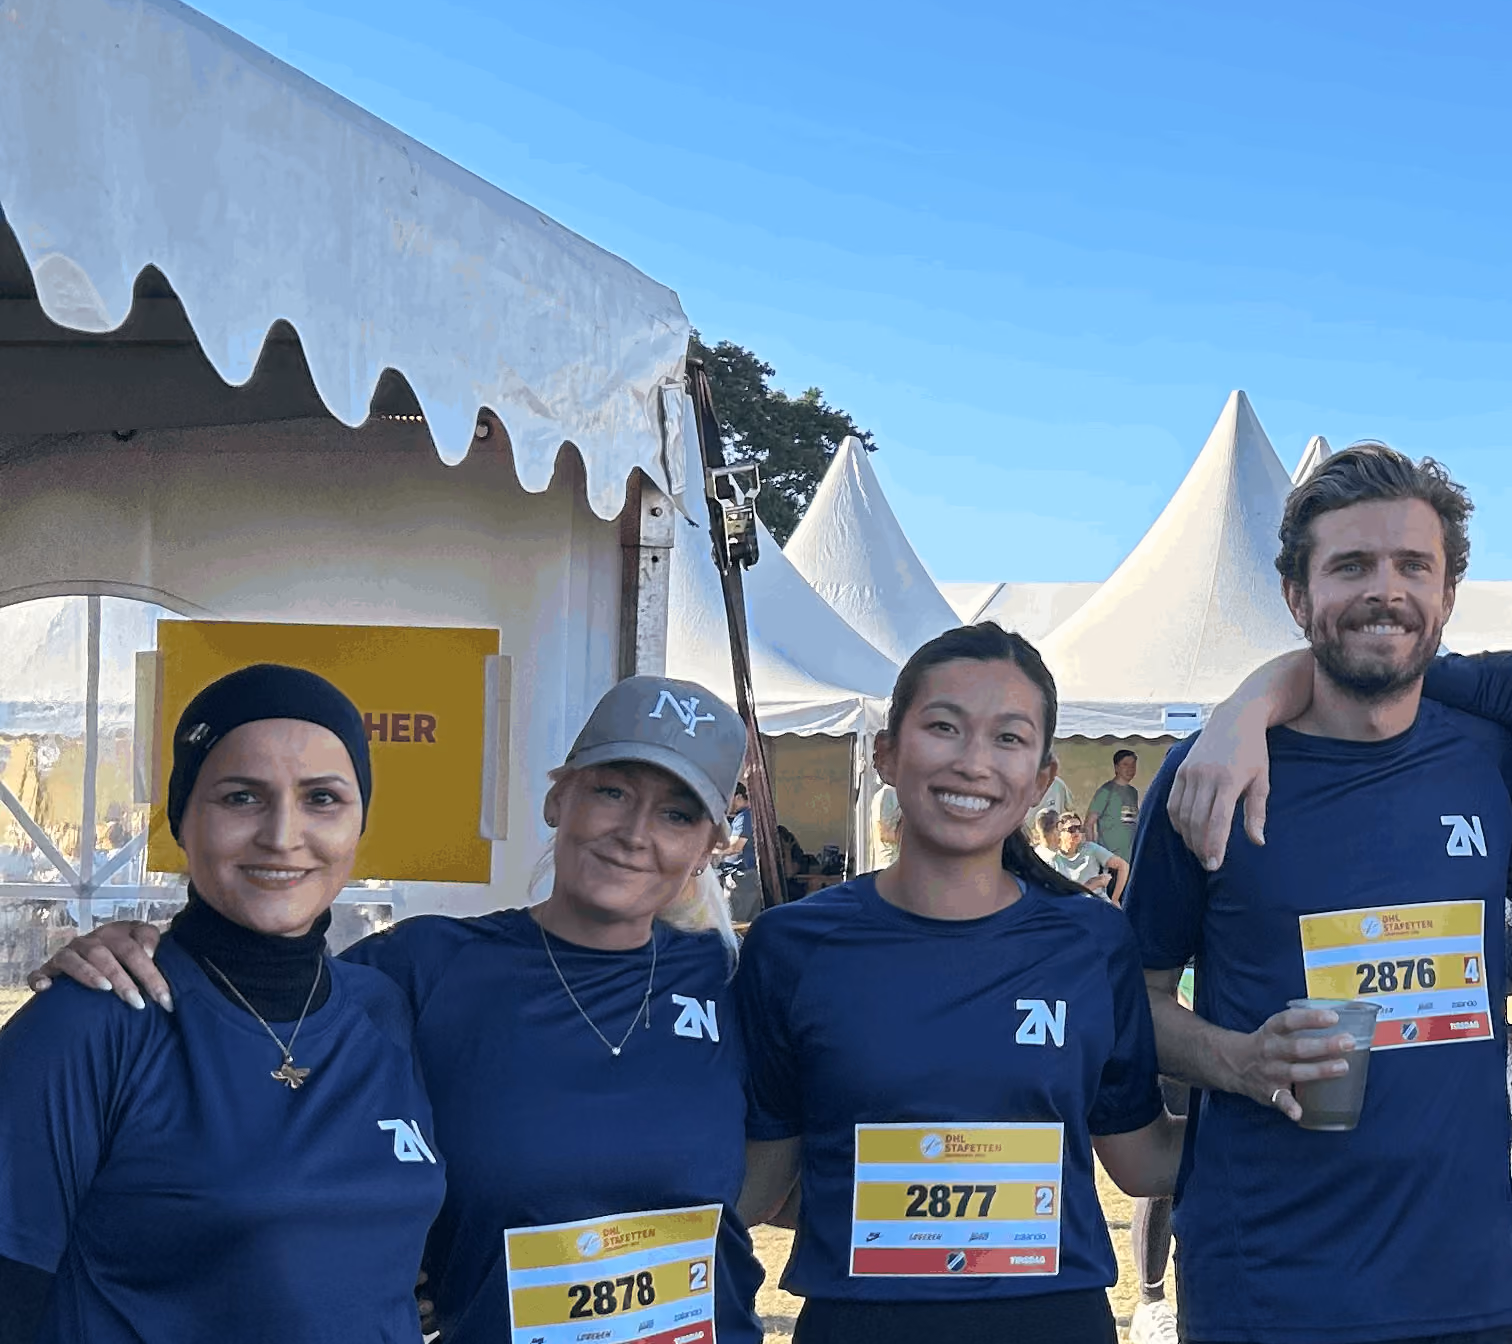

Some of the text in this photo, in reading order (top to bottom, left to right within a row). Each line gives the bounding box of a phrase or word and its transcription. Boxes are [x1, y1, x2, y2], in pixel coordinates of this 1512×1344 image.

[649, 690, 716, 737] NY
[1356, 958, 1436, 995] 2876
[1466, 958, 1480, 983] 4
[944, 1143, 1002, 1153] STAFETTEN
[945, 1134, 966, 1144] DHL
[905, 1185, 997, 1218] 2877
[1035, 1186, 1053, 1214] 2
[690, 1262, 708, 1291] 2
[568, 1270, 656, 1319] 2878
